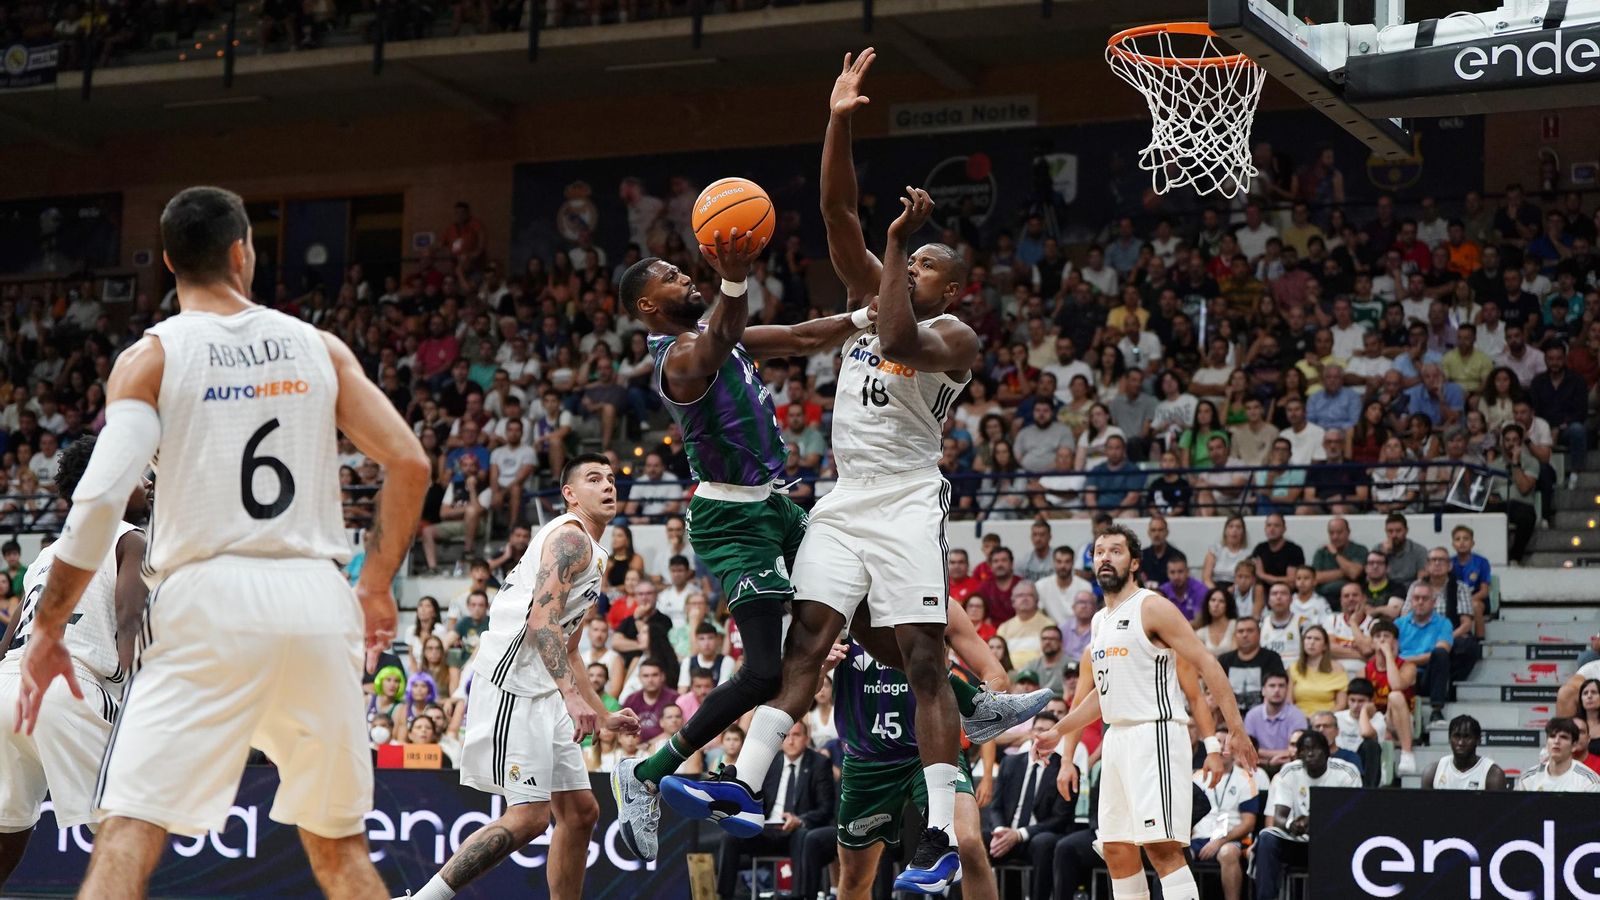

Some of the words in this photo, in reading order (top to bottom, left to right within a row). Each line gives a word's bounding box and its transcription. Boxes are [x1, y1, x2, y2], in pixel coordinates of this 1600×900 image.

[895, 109, 962, 127] Grada
[971, 102, 1031, 121] Norte
[711, 186, 745, 203] endesa
[207, 337, 295, 368] ABALDE
[202, 380, 308, 402] AUTOHERO
[861, 375, 890, 408] 18
[240, 417, 296, 520] 6
[863, 679, 909, 696] málaga
[871, 711, 903, 740] 45
